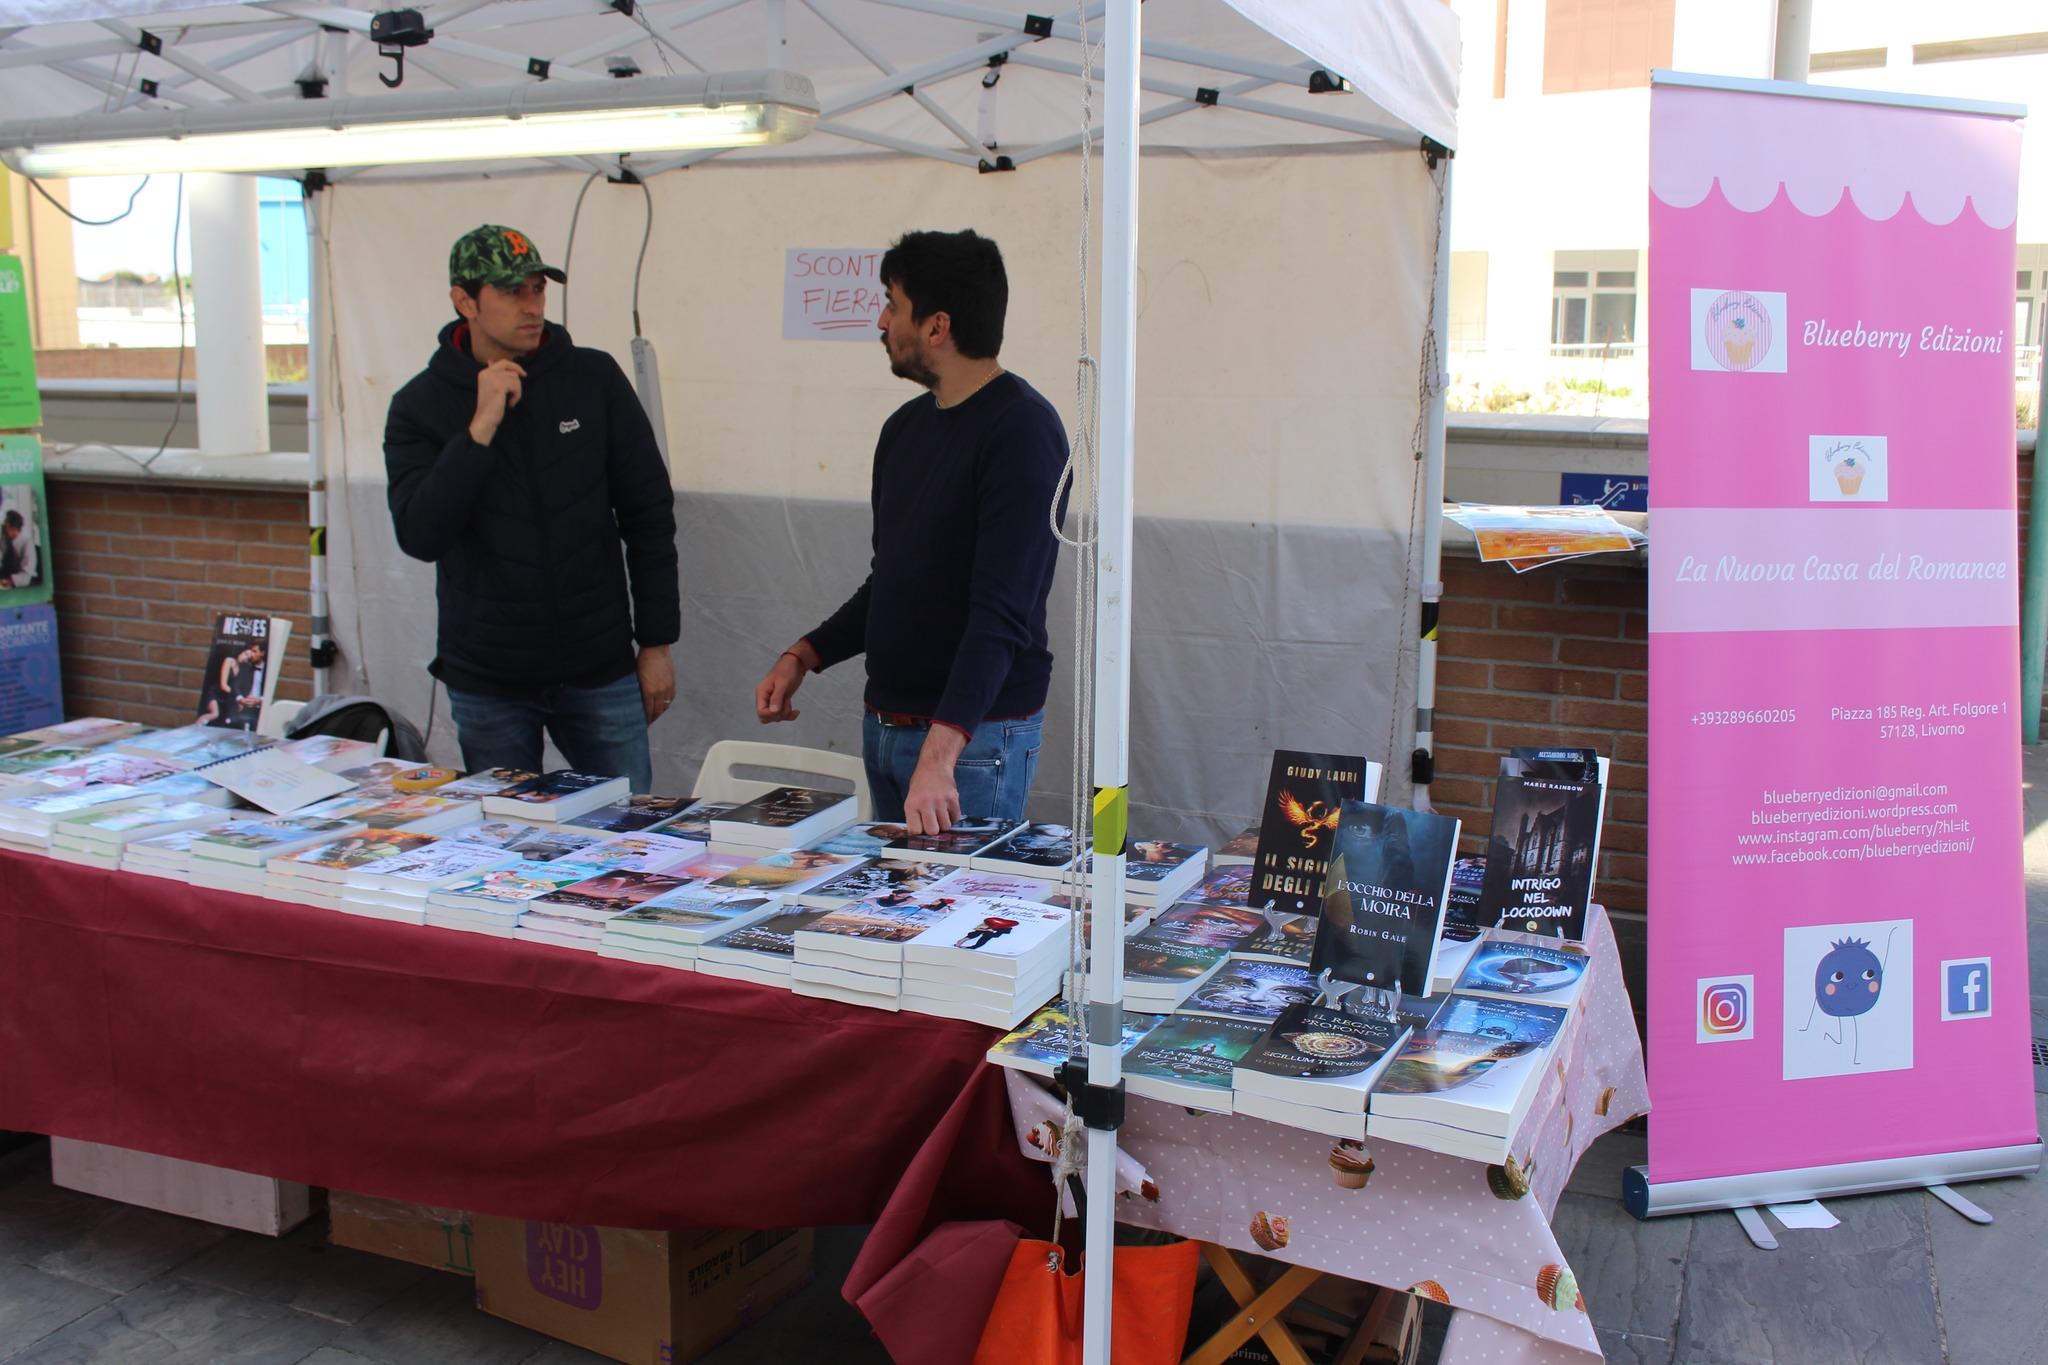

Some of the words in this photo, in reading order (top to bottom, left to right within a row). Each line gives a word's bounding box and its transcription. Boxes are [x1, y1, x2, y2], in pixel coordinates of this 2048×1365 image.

[502, 230, 528, 256] B
[793, 252, 879, 278] SCONT
[803, 287, 881, 315] FIERA
[1802, 319, 1911, 359] Blueberry
[1919, 325, 2004, 354] Edizioni
[1675, 556, 1707, 583] La
[1714, 555, 1796, 583] Nuova
[1803, 555, 1859, 582] Casa
[1868, 553, 1900, 581] del
[1906, 554, 2007, 580] Romance
[1690, 708, 1797, 726] +393289660205
[1831, 706, 1873, 721] Piazza
[1876, 705, 1898, 719] 185
[1900, 705, 1926, 721] Reg.
[1928, 704, 1951, 717] Art.
[1953, 702, 1999, 719] Folgore
[2000, 702, 2008, 715] 1
[1879, 724, 1919, 740] 57128,
[1921, 722, 1966, 738] Livorno
[1286, 765, 1322, 781] GIUDY
[1327, 769, 1358, 783] LAURI
[1523, 780, 1547, 790] MARIE
[1548, 783, 1584, 792] RAINBOW
[1763, 782, 1949, 806] blueberryedizioni@gmail.com
[1751, 801, 1959, 826] blueberryedizioni.wordpress.com
[1737, 819, 1971, 846] www.instagram.com/blueberry/?hl=it
[1732, 837, 1976, 867] www.facebook.com/blueberryedizioni/
[1262, 872, 1312, 897] DEGLI
[1336, 878, 1393, 899] L'OCCHIO
[1394, 890, 1435, 908] DELLA
[1511, 877, 1562, 891] INTRIGO
[1359, 897, 1412, 920] MOIRA
[1523, 892, 1550, 904] NEL
[1501, 906, 1573, 918] LOCKDOWN
[1180, 1016, 1220, 1026] GIADA
[1301, 1018, 1391, 1038] PROFONDO
[1331, 1017, 1389, 1032] REGNO
[1262, 1050, 1315, 1065] SIGILLUM
[536, 1222, 589, 1263] CLAY
[687, 1246, 735, 1283] FRAGILE
[539, 1258, 587, 1300] HEY
